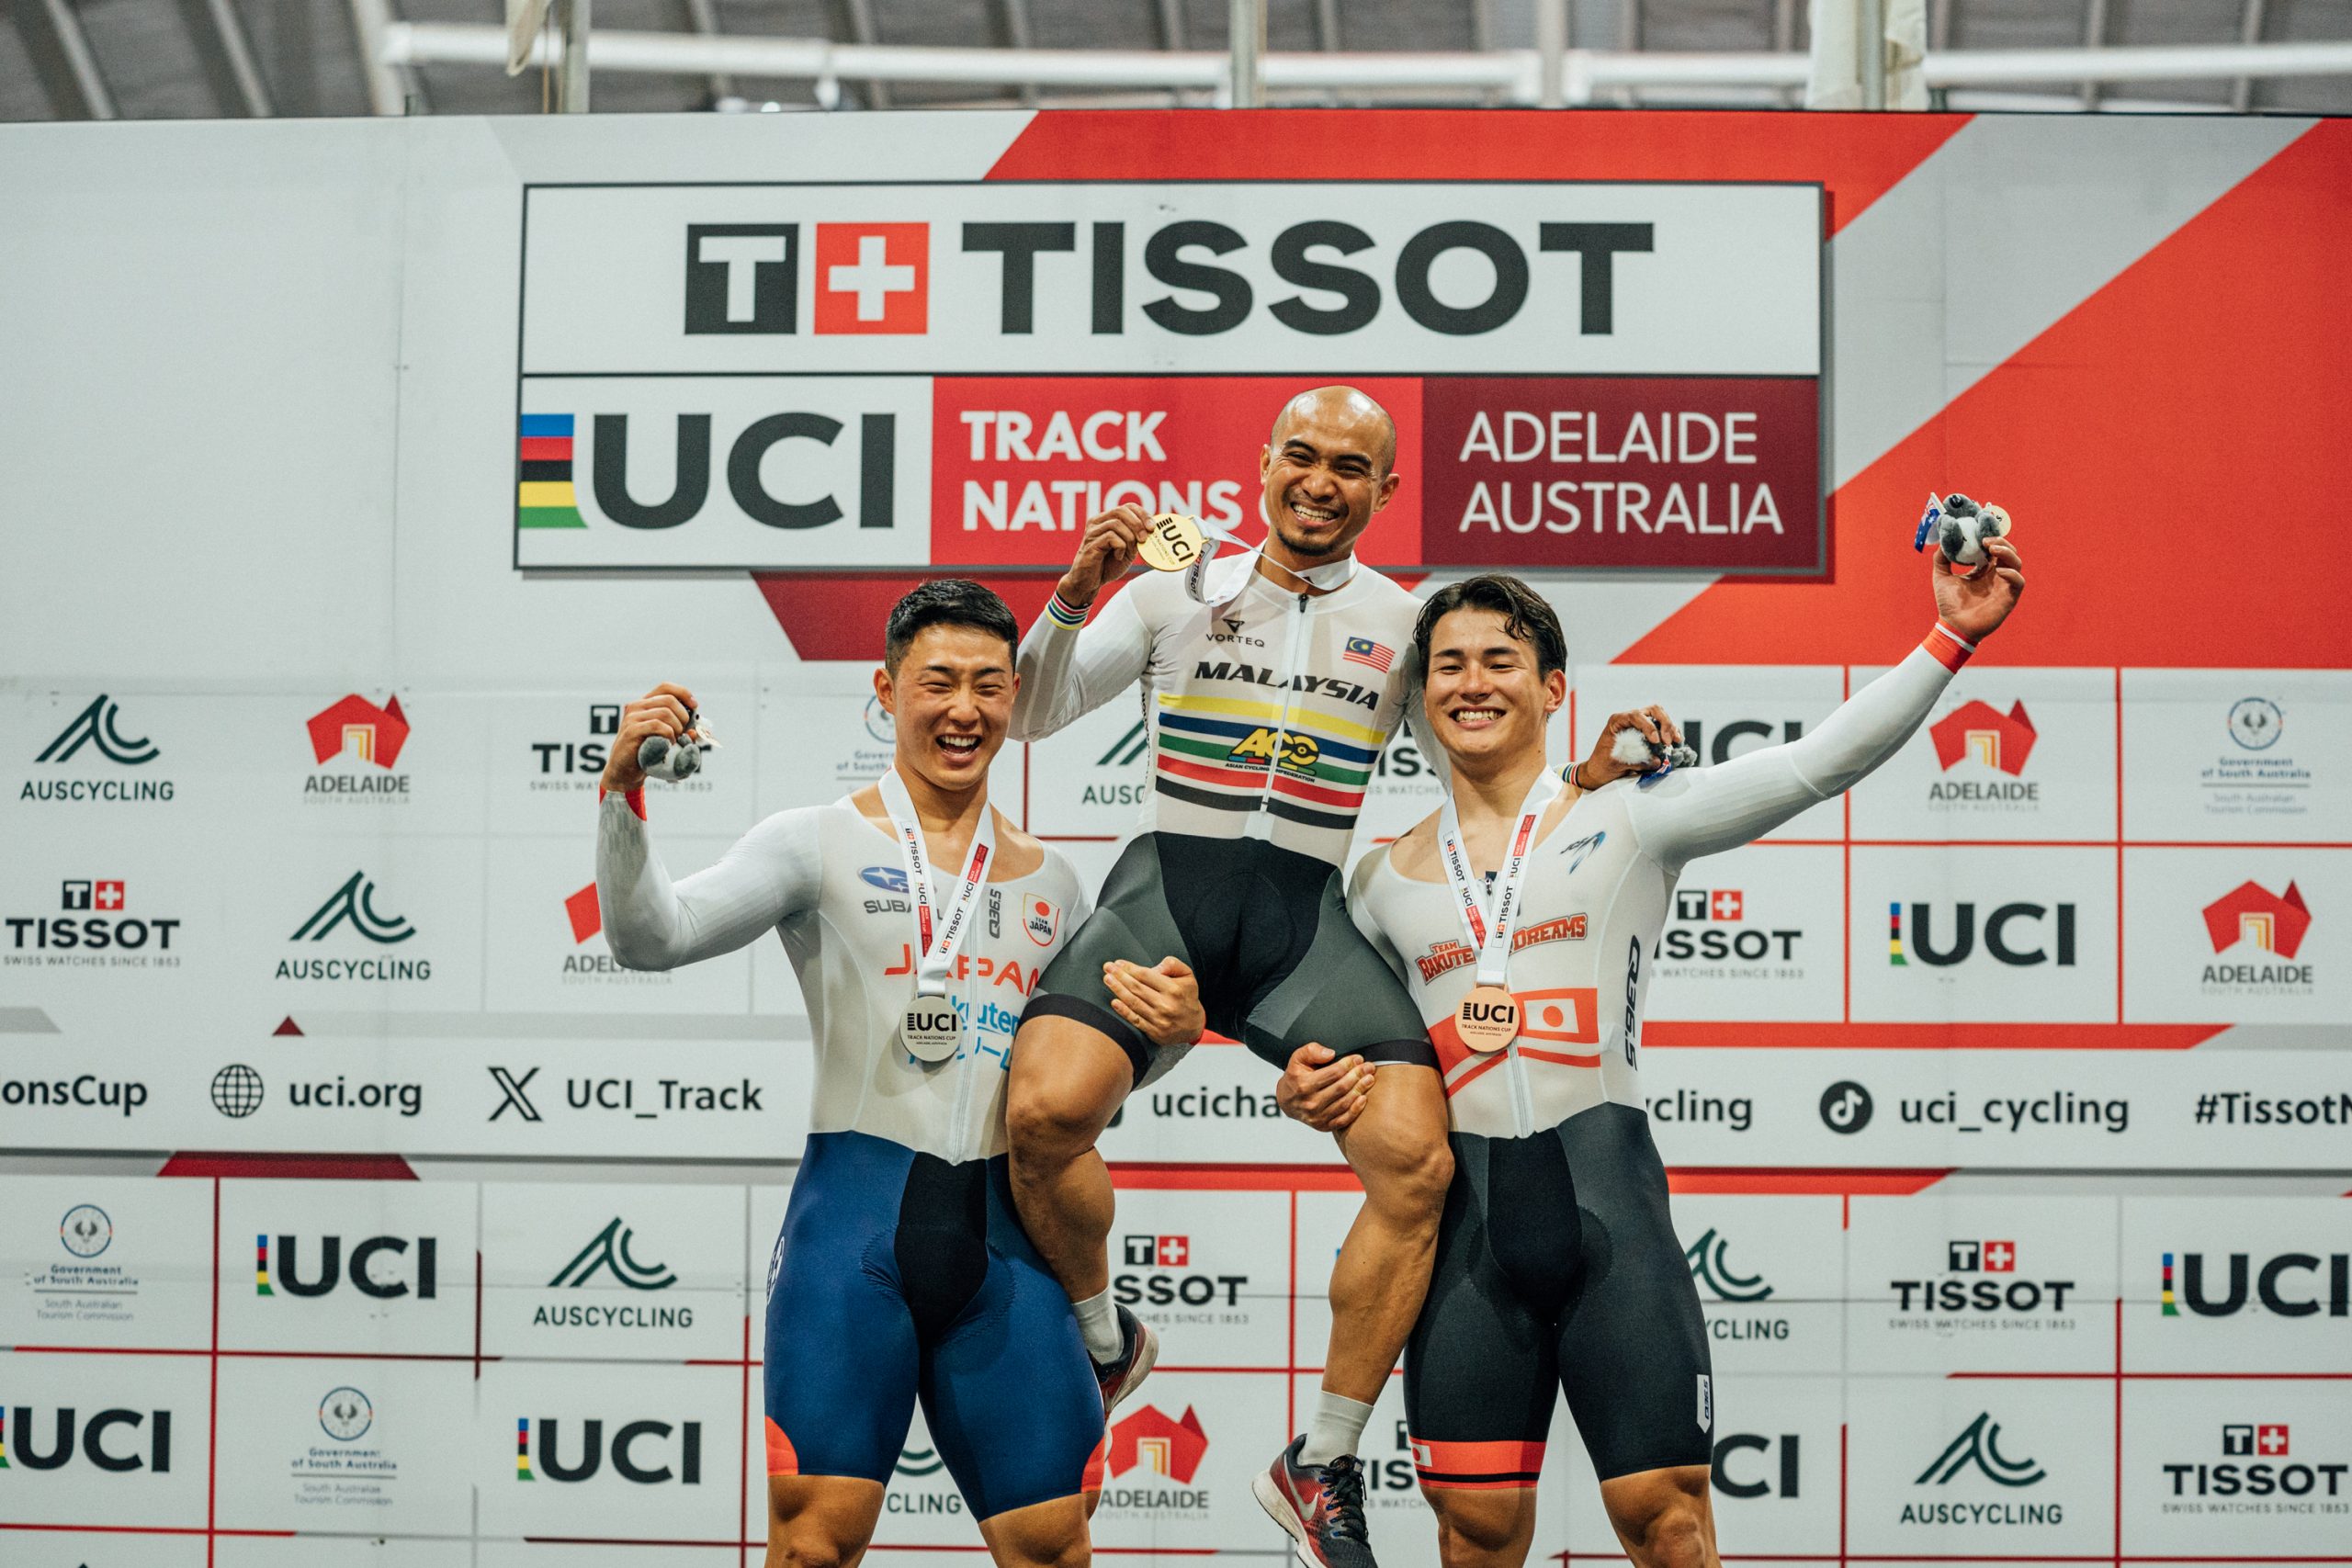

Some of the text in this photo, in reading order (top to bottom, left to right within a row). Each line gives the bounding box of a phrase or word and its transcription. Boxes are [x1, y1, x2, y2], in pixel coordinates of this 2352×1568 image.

[961, 220, 1656, 336] TISSOT
[960, 411, 1168, 462] TRACK
[1459, 410, 1758, 464] ADELAIDE
[593, 411, 897, 530] UCI
[962, 479, 1244, 531] NATIONS
[1459, 480, 1785, 535] AUSTRALIA
[1162, 525, 1194, 563] UCI
[1205, 633, 1266, 649] VORTEQ
[1194, 661, 1380, 711] MALAYSIA
[20, 781, 175, 801] AUSCYCLING
[304, 774, 411, 794] ADELAIDE
[1275, 768, 1316, 783] NFEDERATION
[1928, 782, 2039, 800] ADELAIDE
[909, 840, 923, 875] TISSOT
[1450, 851, 1465, 882] TISSOT
[1511, 857, 1521, 874] UCI
[918, 886, 928, 905] UCI
[965, 882, 976, 899] UCI
[1463, 888, 1474, 907] UCI
[1498, 886, 1513, 923] TISSOT
[945, 907, 965, 940] TISSOT
[989, 888, 1002, 939] Q36.5
[1029, 920, 1053, 937] JAPAN
[6, 918, 180, 950] TISSOT
[1431, 942, 1459, 954] TEAM
[1512, 915, 1588, 953] DREAMS
[1654, 929, 1803, 961] SSOT
[1911, 902, 2076, 967] UCI
[47, 955, 106, 965] WATCHES
[110, 956, 148, 966] SINCE
[276, 960, 431, 980] AUSCYCLING
[1417, 947, 1477, 983] RAKUTE
[2202, 965, 2314, 984] ADELAIDE
[916, 1013, 957, 1032] UCI
[1472, 1003, 1515, 1024] UCI
[288, 1077, 422, 1117] uci.org
[566, 1078, 763, 1119] UCI_Track
[1152, 1086, 1282, 1118] ucicha
[1645, 1089, 1752, 1131] cling
[1899, 1090, 2130, 1133] uci_cycling
[34, 1275, 139, 1285] of South Australia
[51, 1264, 121, 1275] Government
[277, 1235, 437, 1300] UCI
[1114, 1275, 1248, 1306] SSOT
[1890, 1280, 2075, 1313] TISSOT
[2183, 1252, 2350, 1317] UCI
[534, 1306, 694, 1328] AUSCYCLING
[12, 1406, 172, 1473] UCI
[537, 1417, 703, 1486] UCI
[291, 1459, 397, 1470] of South Australia
[1711, 1434, 1800, 1499] CI
[2163, 1463, 2349, 1496] TISSOT
[1100, 1489, 1210, 1509] ADELAIDE
[1900, 1504, 2064, 1525] AUSCYCLING
